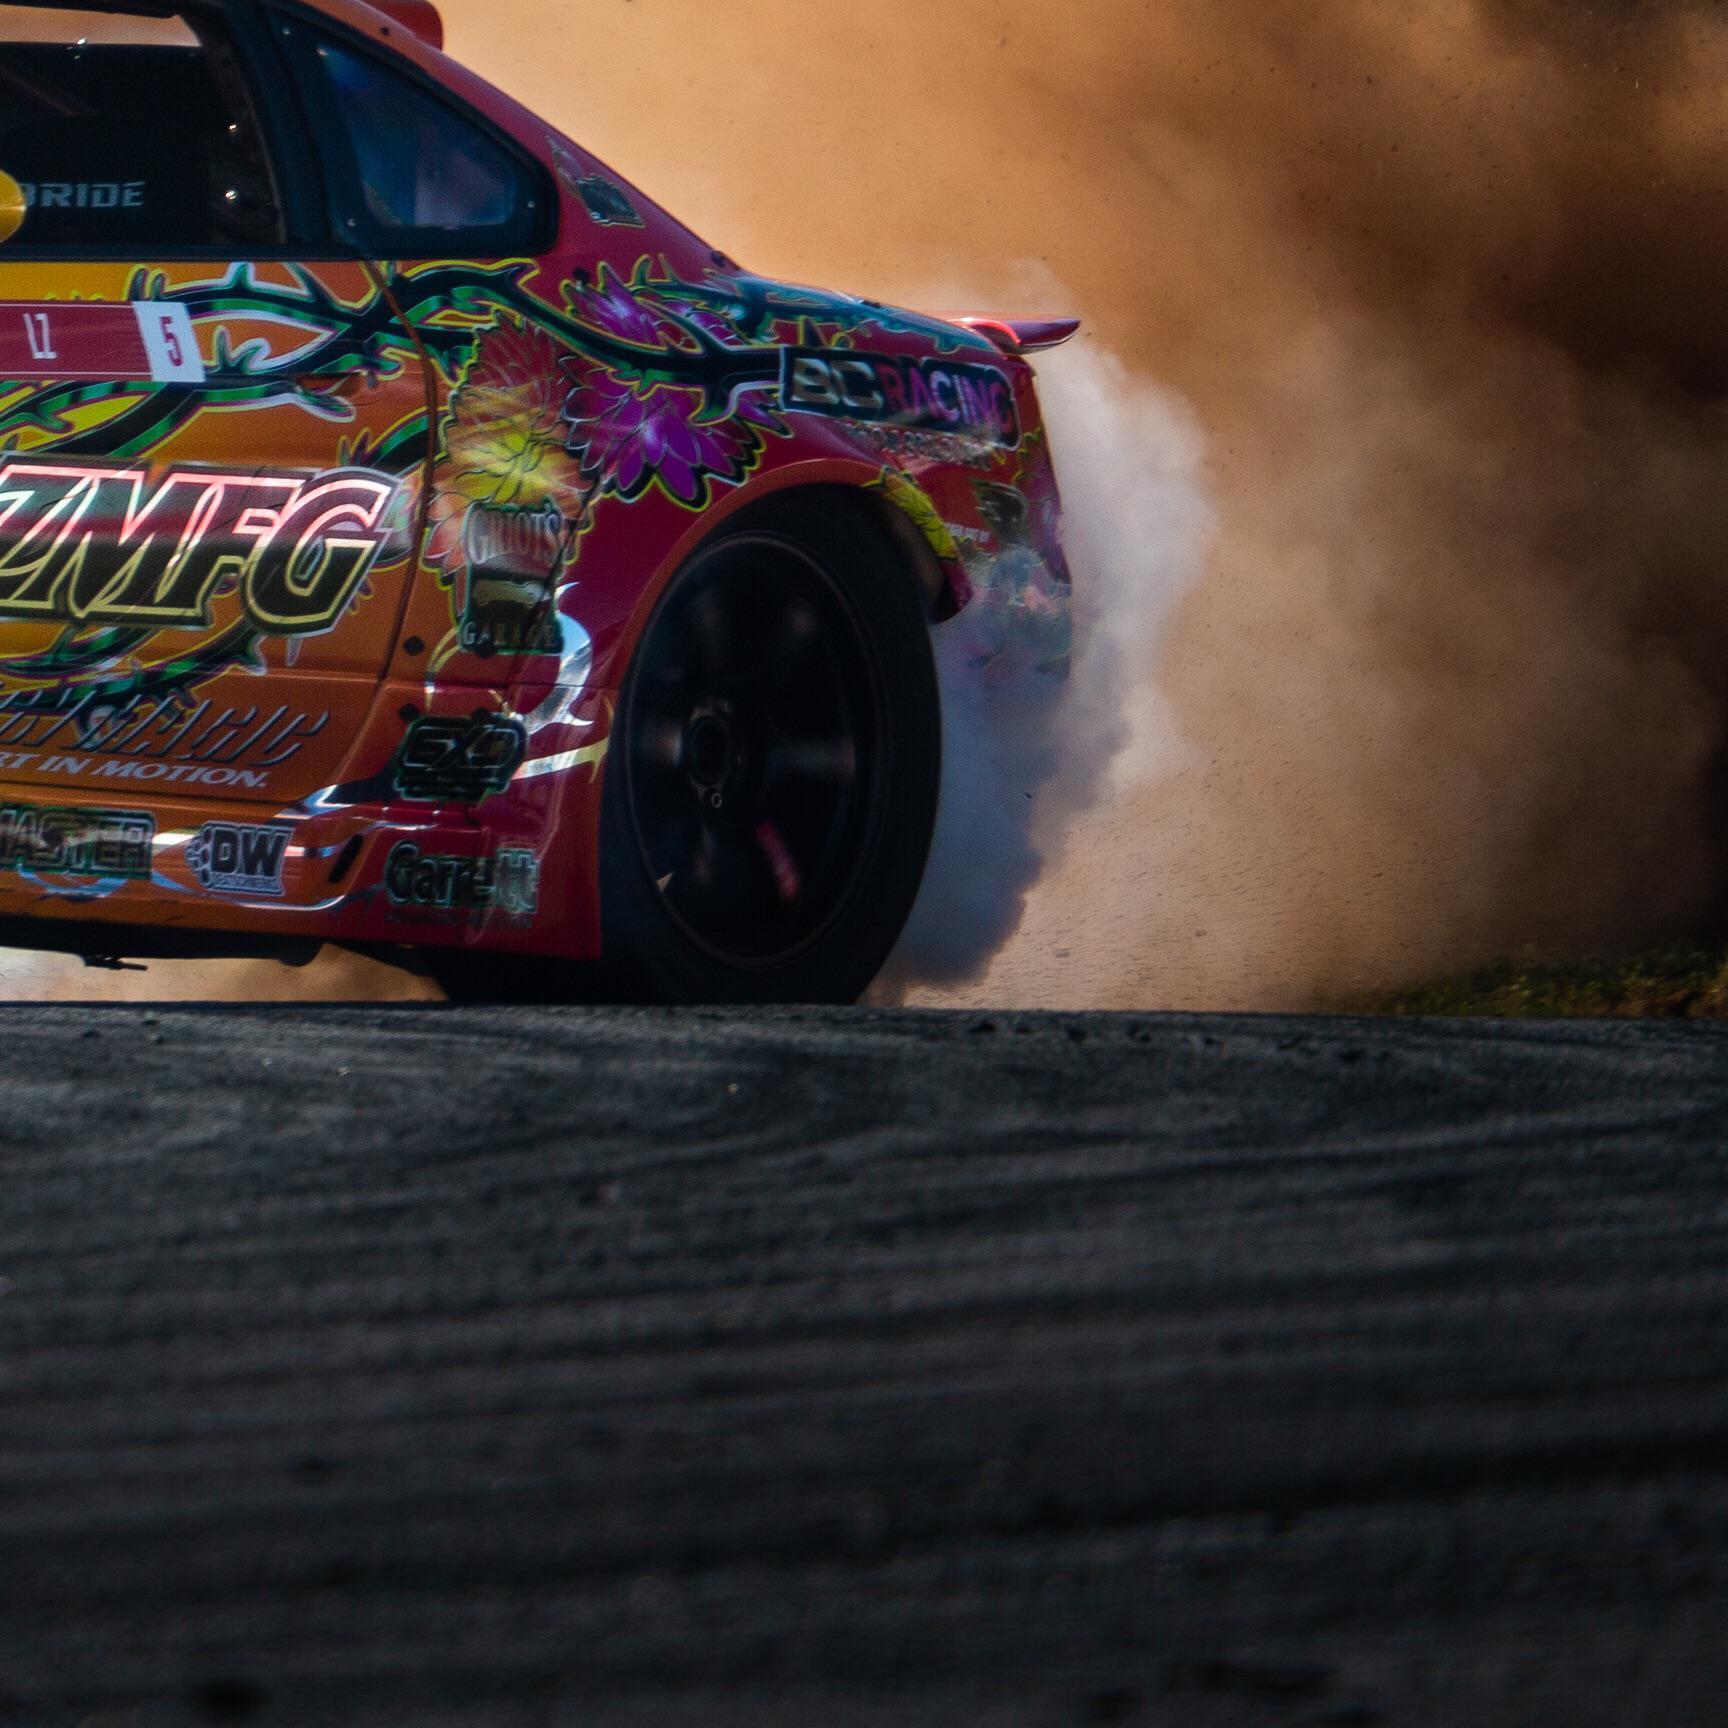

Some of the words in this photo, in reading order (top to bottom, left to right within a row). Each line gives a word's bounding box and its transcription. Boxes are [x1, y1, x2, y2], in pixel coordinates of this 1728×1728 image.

[158, 315, 184, 368] 5
[791, 356, 886, 411] BC
[874, 363, 1016, 435] RACING
[36, 755, 93, 775] IN
[92, 759, 272, 788] MOTION.
[211, 829, 289, 879] DW
[385, 840, 540, 914] Garrett
